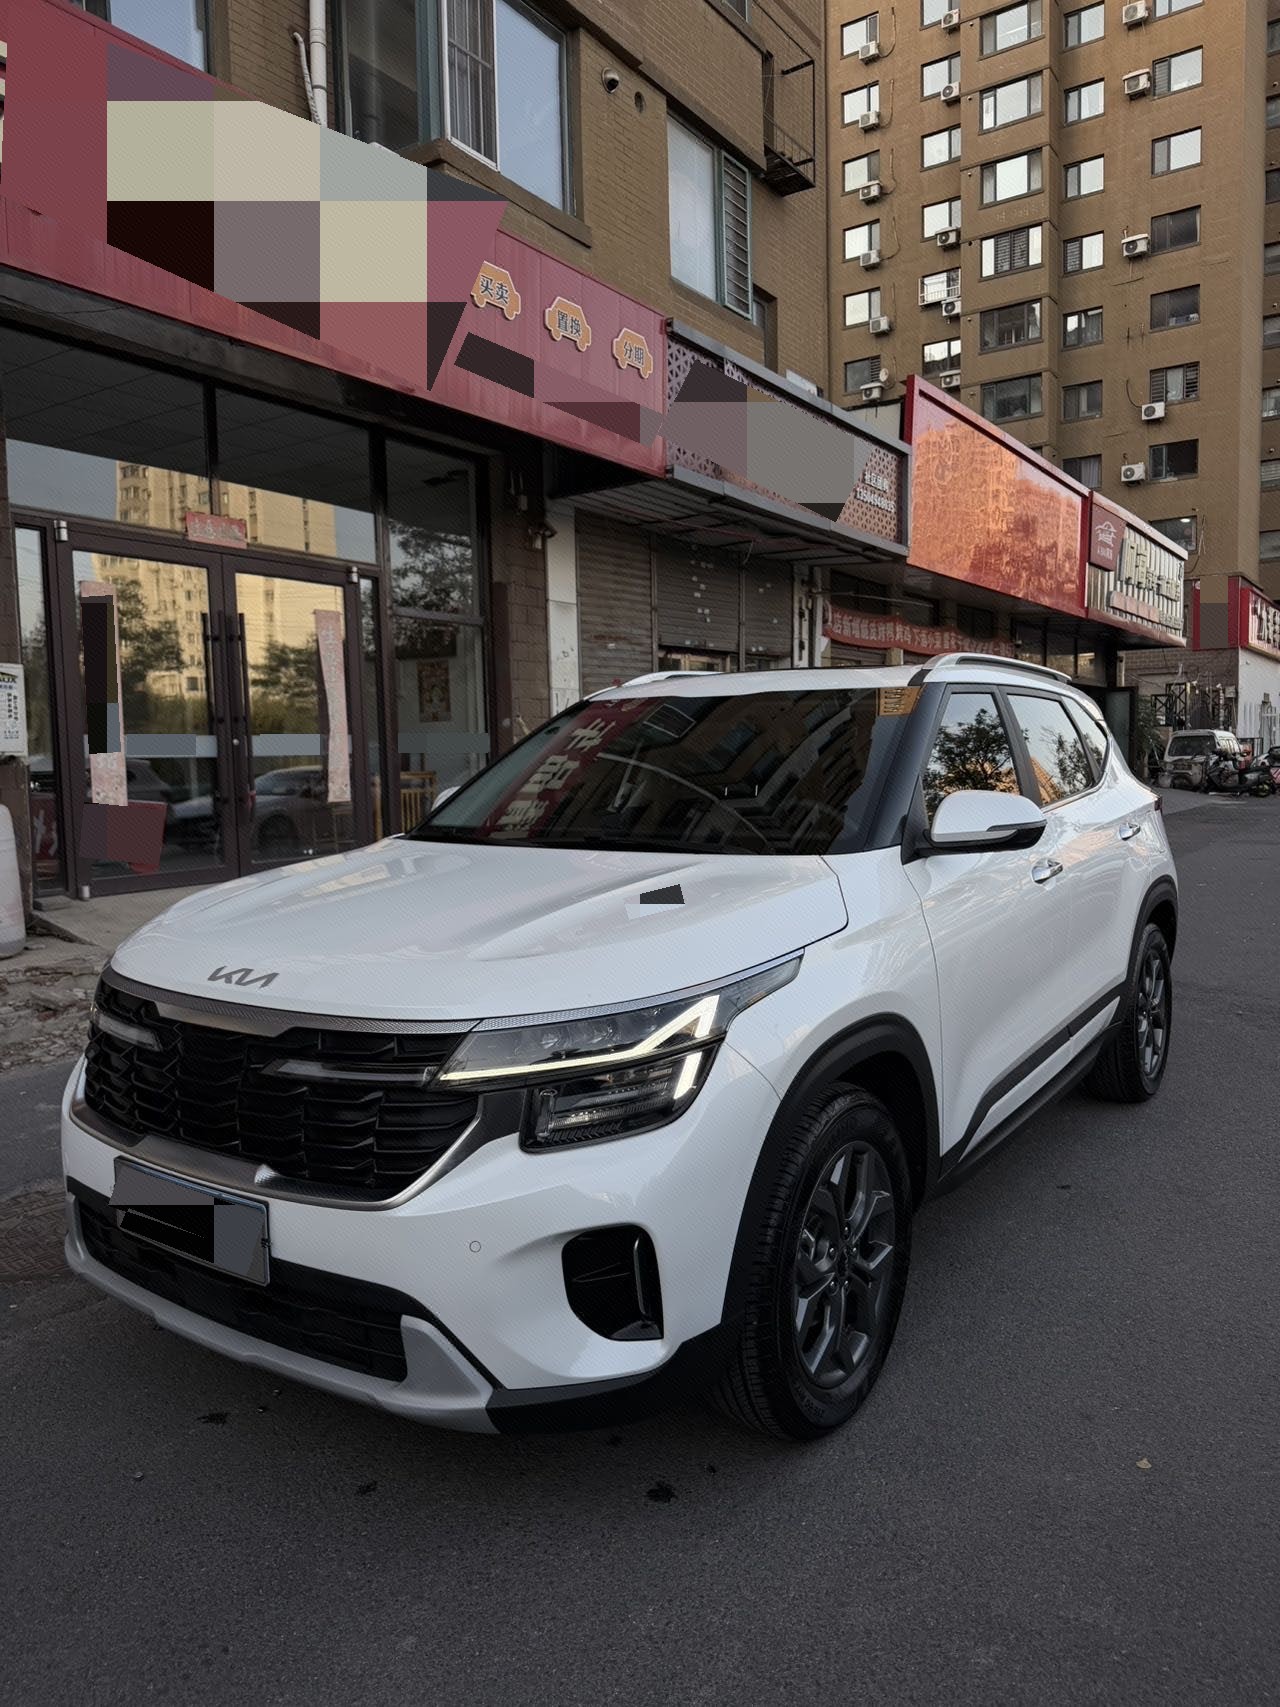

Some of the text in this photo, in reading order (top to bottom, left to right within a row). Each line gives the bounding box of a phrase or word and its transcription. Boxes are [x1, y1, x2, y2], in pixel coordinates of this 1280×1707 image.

[480, 274, 509, 304] 买卖
[557, 310, 582, 336] 置换
[622, 341, 645, 366] 分期
[207, 965, 280, 989] KIA
